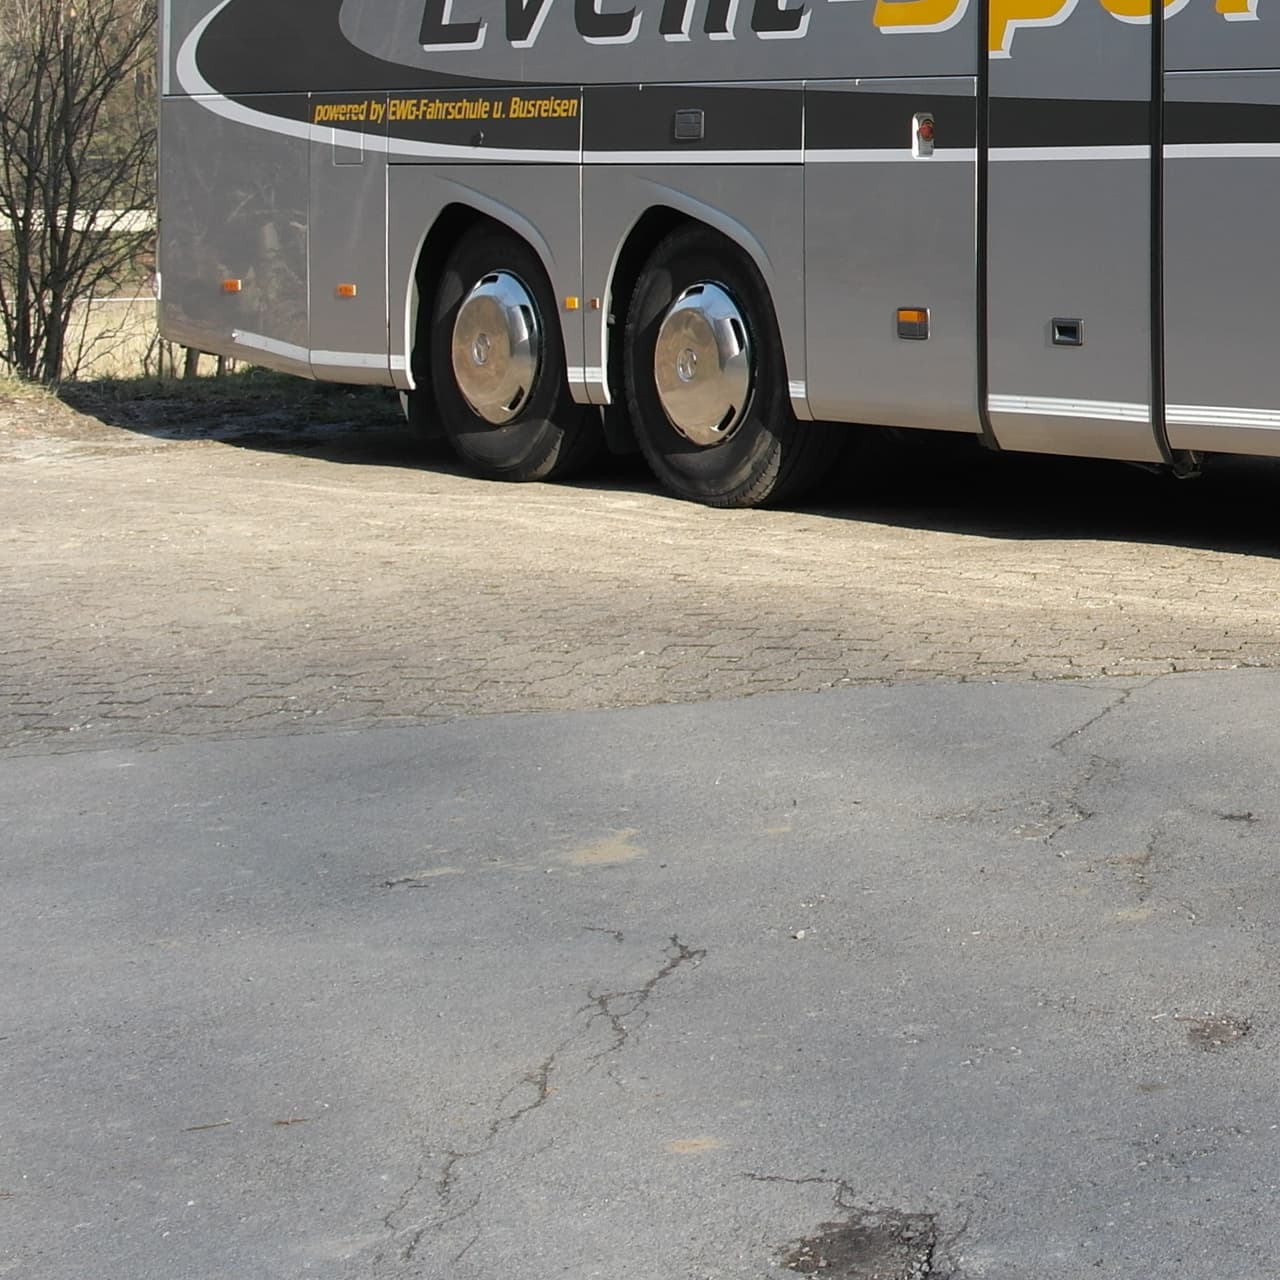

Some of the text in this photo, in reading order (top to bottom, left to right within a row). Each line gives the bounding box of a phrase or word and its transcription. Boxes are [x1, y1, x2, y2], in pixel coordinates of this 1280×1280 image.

[314, 96, 578, 124] powered by EWG-Fahrschule u. Busreisen
